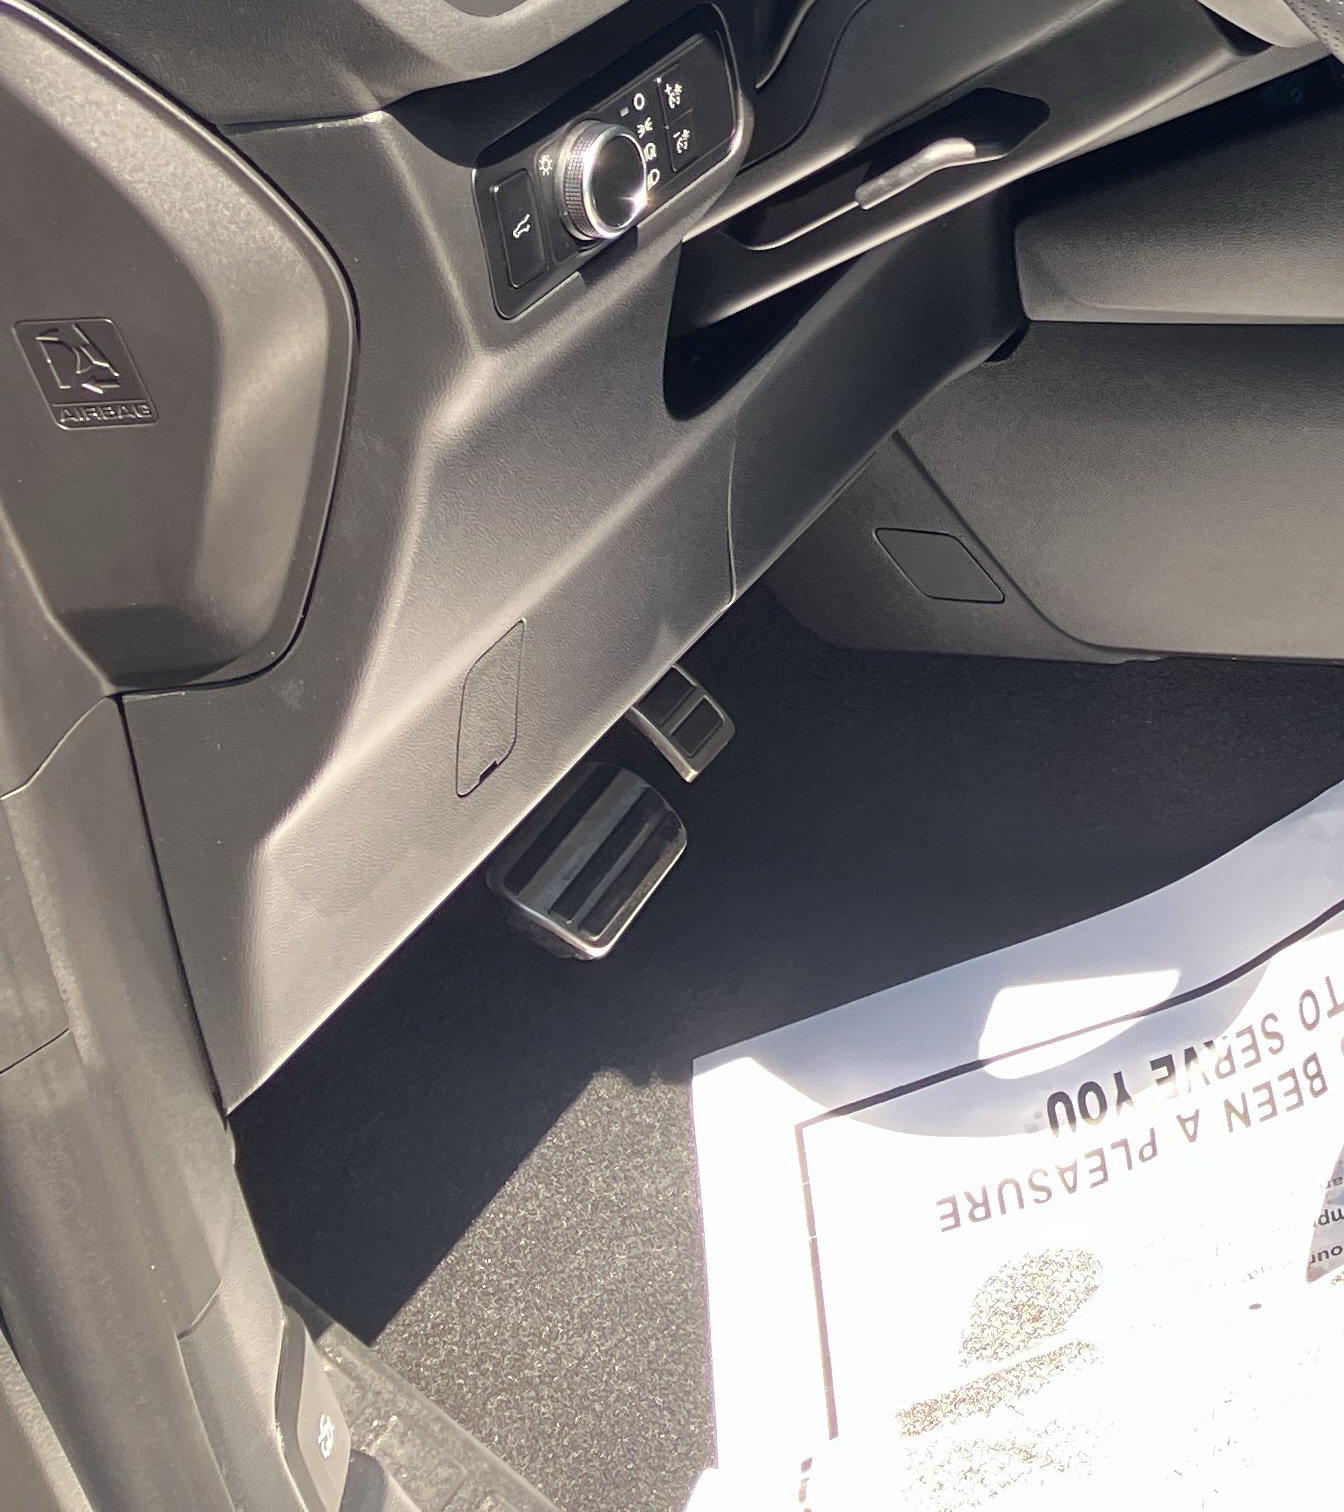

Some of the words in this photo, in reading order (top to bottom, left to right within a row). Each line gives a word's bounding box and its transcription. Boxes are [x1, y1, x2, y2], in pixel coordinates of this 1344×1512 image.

[60, 404, 153, 423] AIRBAG
[1149, 1011, 1286, 1100] SERVE
[1223, 1051, 1330, 1134] BEEN
[1046, 1071, 1135, 1137] YOU
[1176, 1108, 1201, 1144] A
[936, 1126, 1159, 1233] PLEASURE
